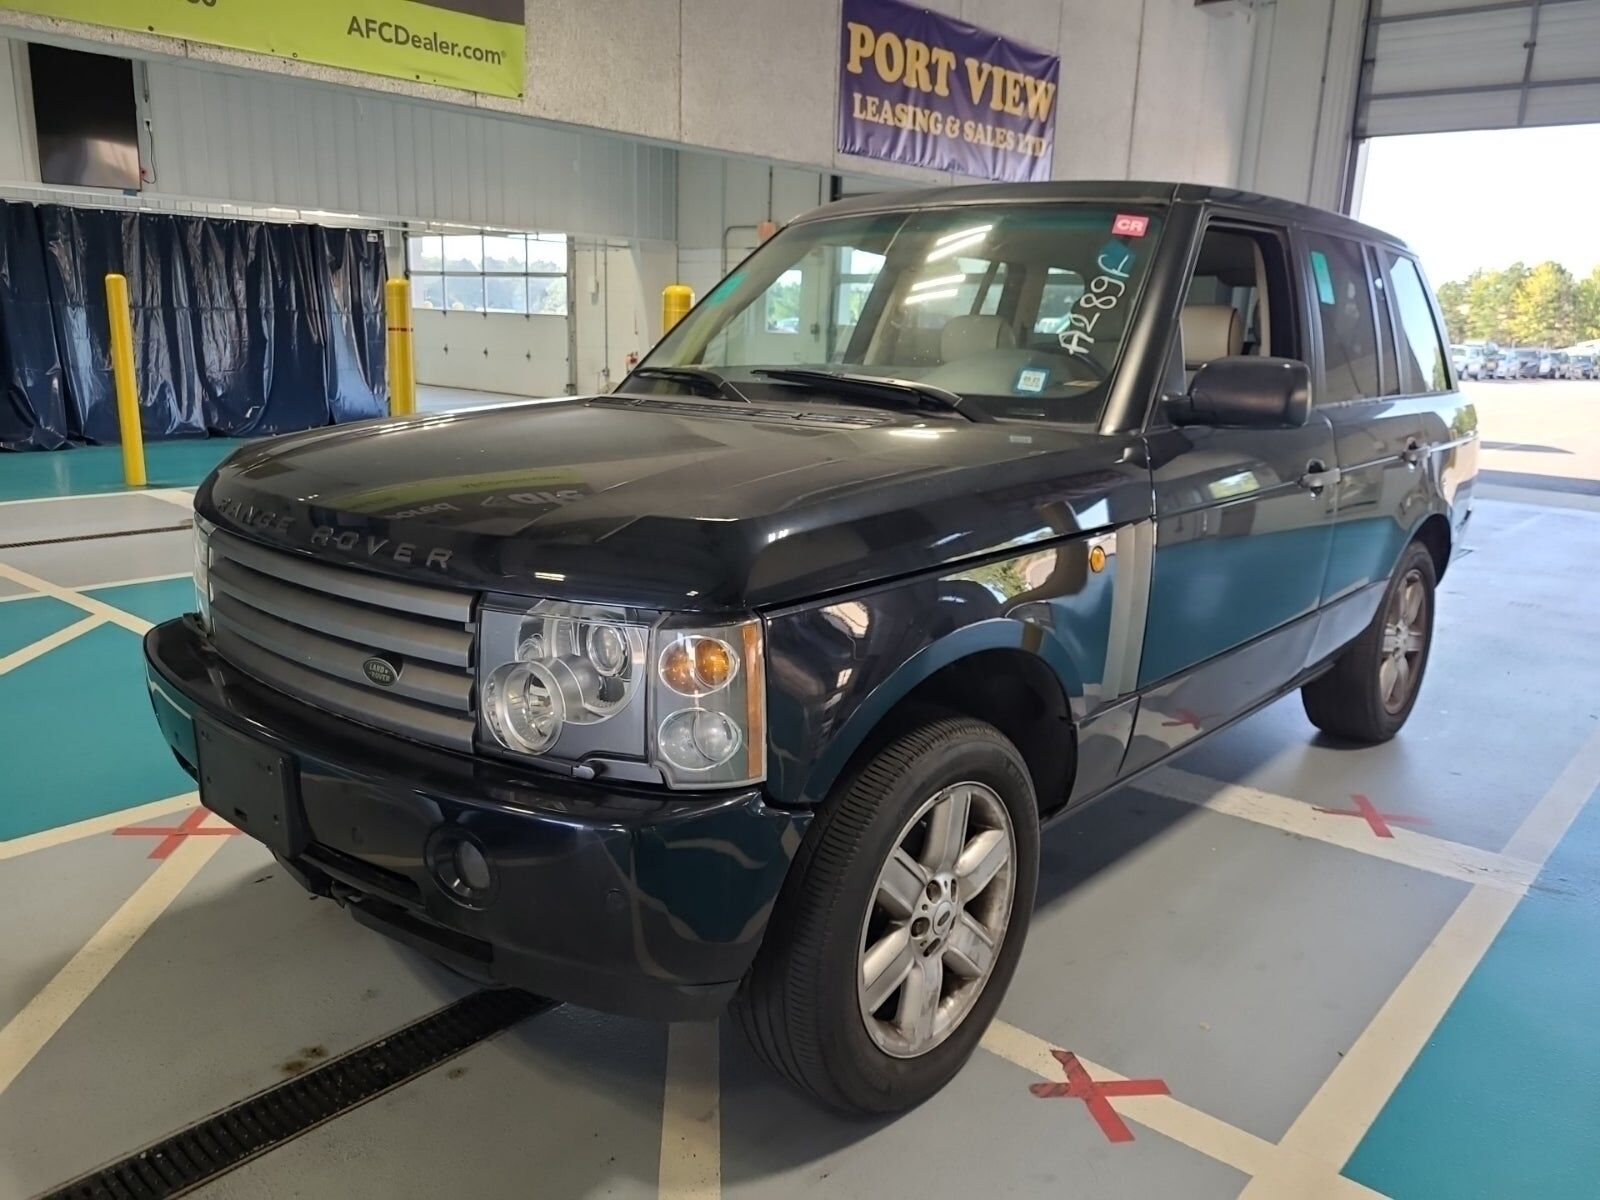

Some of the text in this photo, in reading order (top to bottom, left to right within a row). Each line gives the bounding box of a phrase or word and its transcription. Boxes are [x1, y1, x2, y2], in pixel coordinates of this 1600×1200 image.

[347, 15, 502, 65] AFCDealer.com
[846, 21, 1056, 122] PORT VIEW
[852, 92, 1047, 157] LEASING & SALES LTD
[1116, 218, 1144, 232] CR
[310, 525, 454, 570] ROVER
[369, 663, 385, 674] LAND
